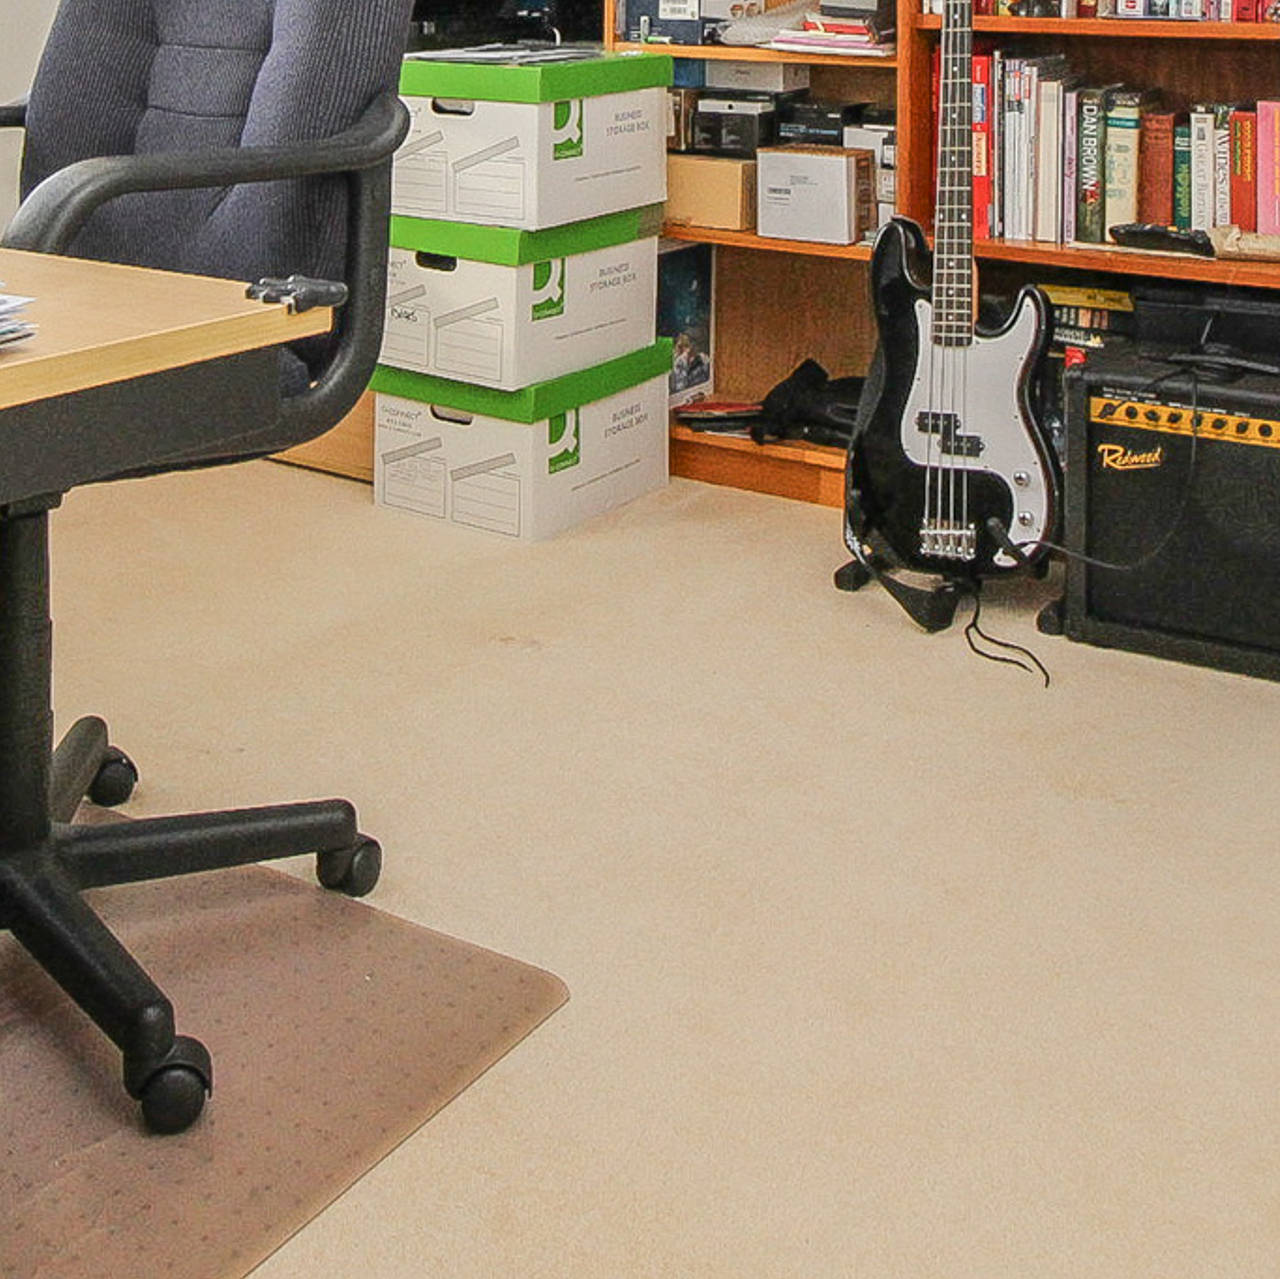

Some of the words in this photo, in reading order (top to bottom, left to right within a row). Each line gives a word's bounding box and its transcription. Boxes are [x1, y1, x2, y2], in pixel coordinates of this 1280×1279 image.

[1082, 105, 1098, 136] DAN
[1082, 137, 1098, 191] BROWN
[1216, 131, 1230, 185] Wines
[1097, 442, 1163, 471] Redwood
